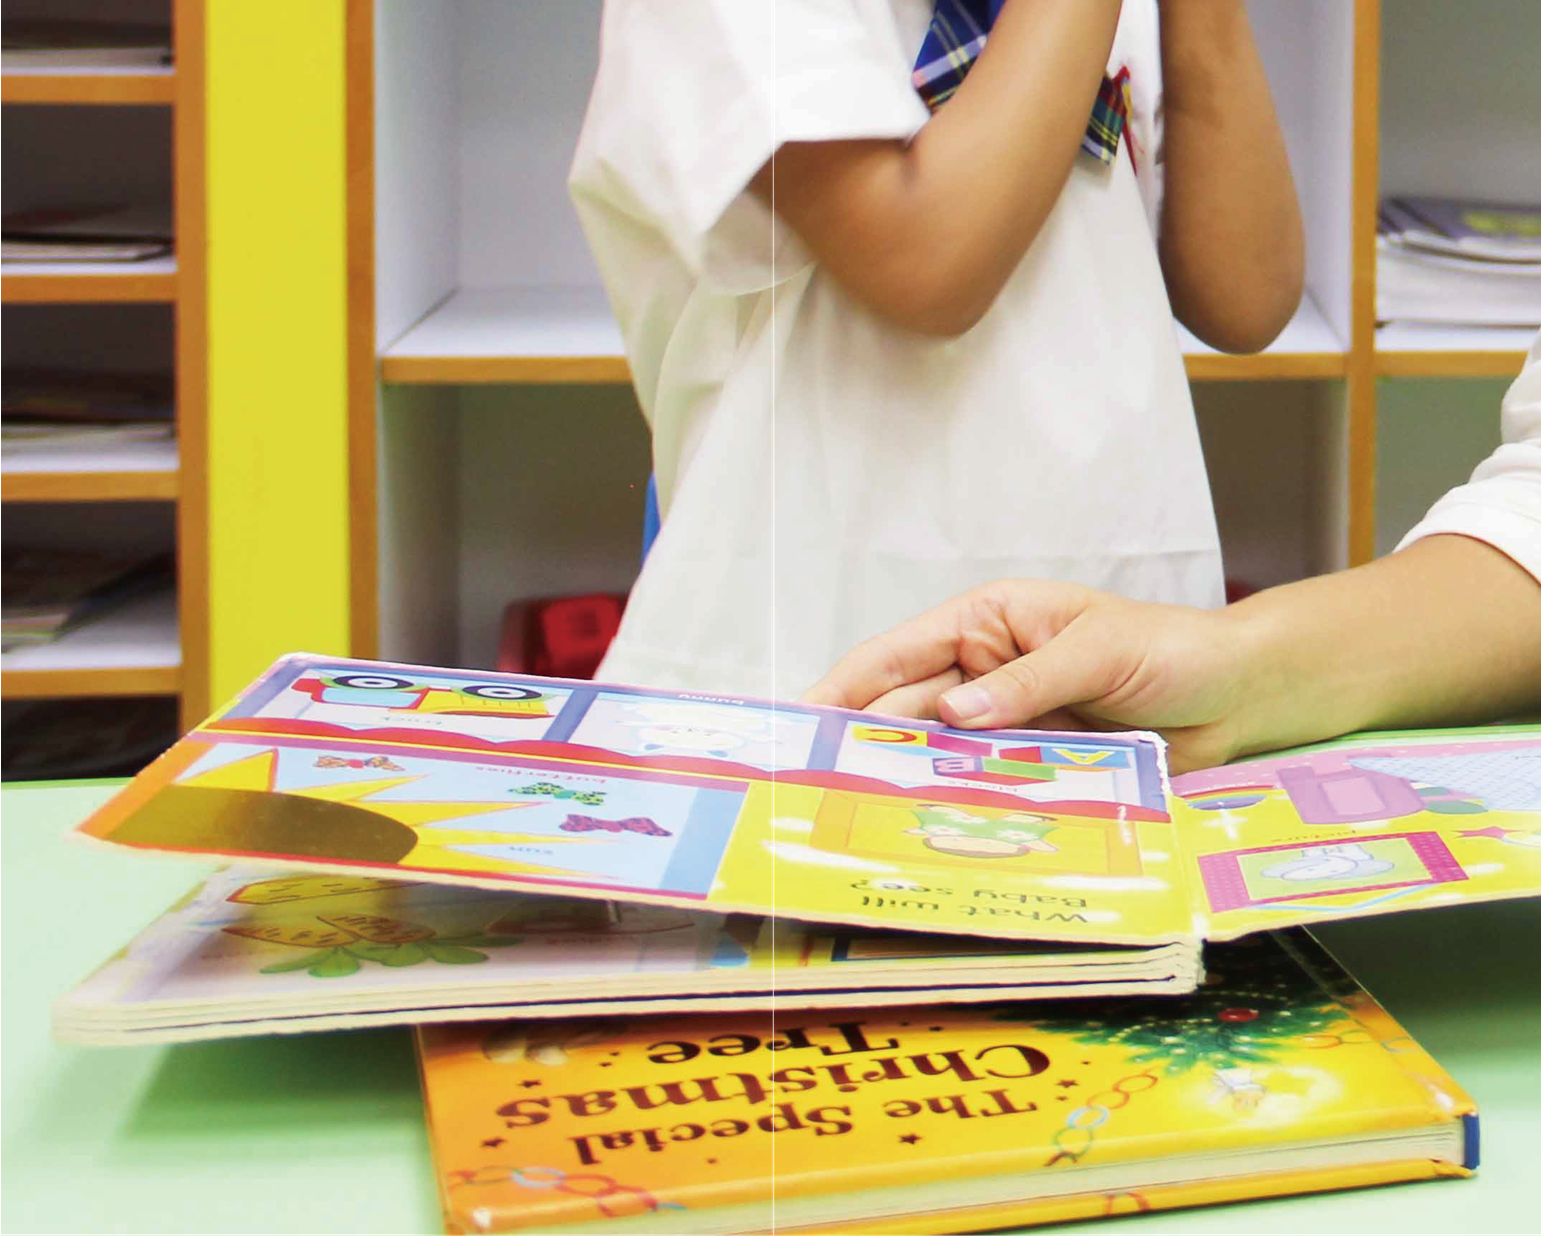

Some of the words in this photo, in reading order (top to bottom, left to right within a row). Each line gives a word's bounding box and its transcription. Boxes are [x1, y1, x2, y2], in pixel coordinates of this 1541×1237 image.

[848, 877, 952, 893] see?
[971, 888, 1087, 907] Baby
[859, 894, 939, 909] will
[956, 903, 1087, 922] What
[644, 1019, 899, 1065] Tree
[494, 1042, 1050, 1129] Christmas
[880, 1086, 1036, 1121] The
[565, 1100, 853, 1165] Special
